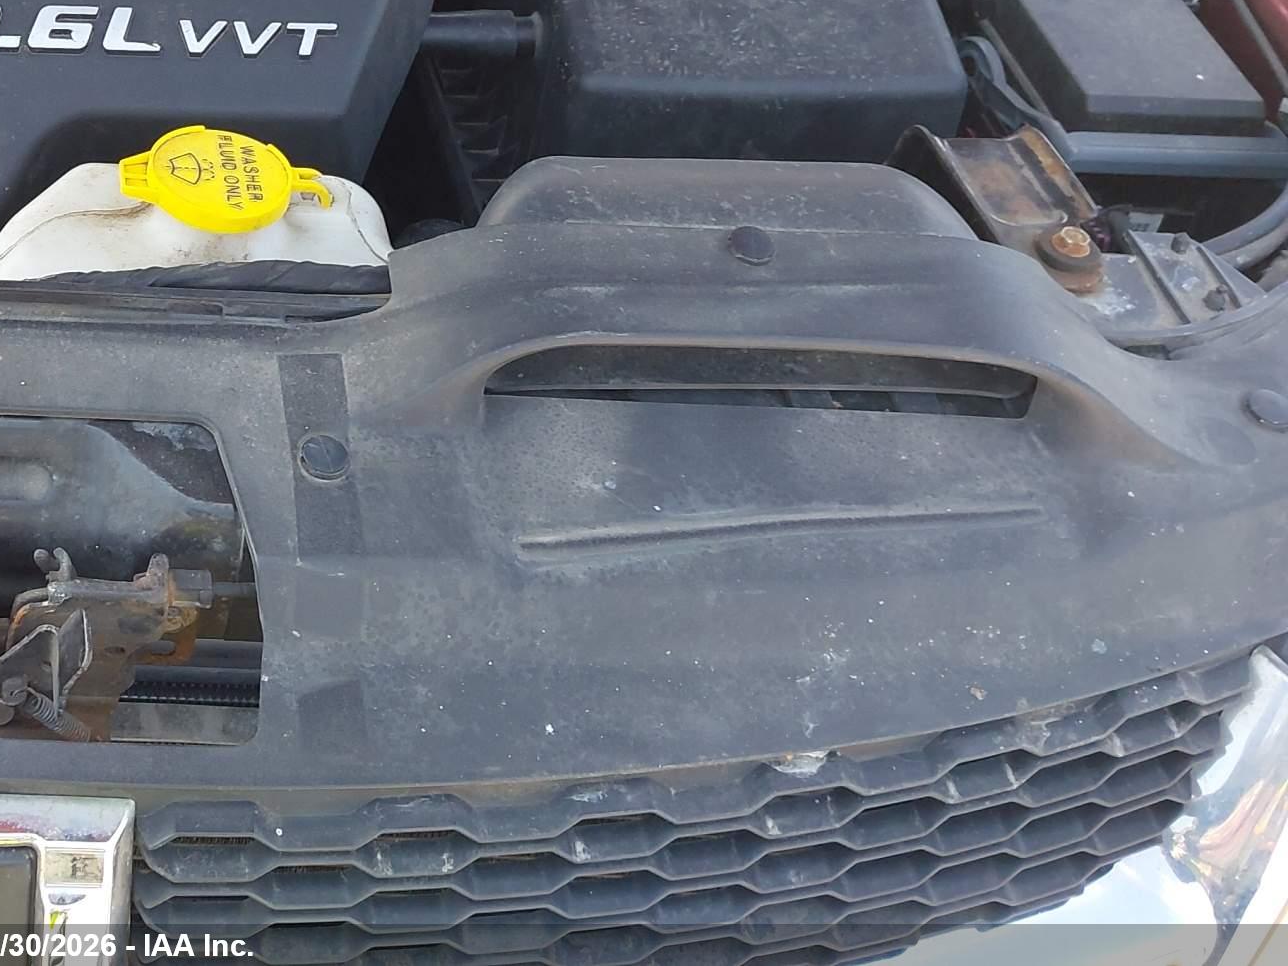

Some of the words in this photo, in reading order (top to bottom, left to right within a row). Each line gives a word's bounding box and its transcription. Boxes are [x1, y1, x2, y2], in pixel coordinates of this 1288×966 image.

[179, 18, 339, 57] VVT
[217, 134, 237, 174] FLUID
[239, 145, 264, 202] WASHER
[223, 175, 244, 211] ONLY
